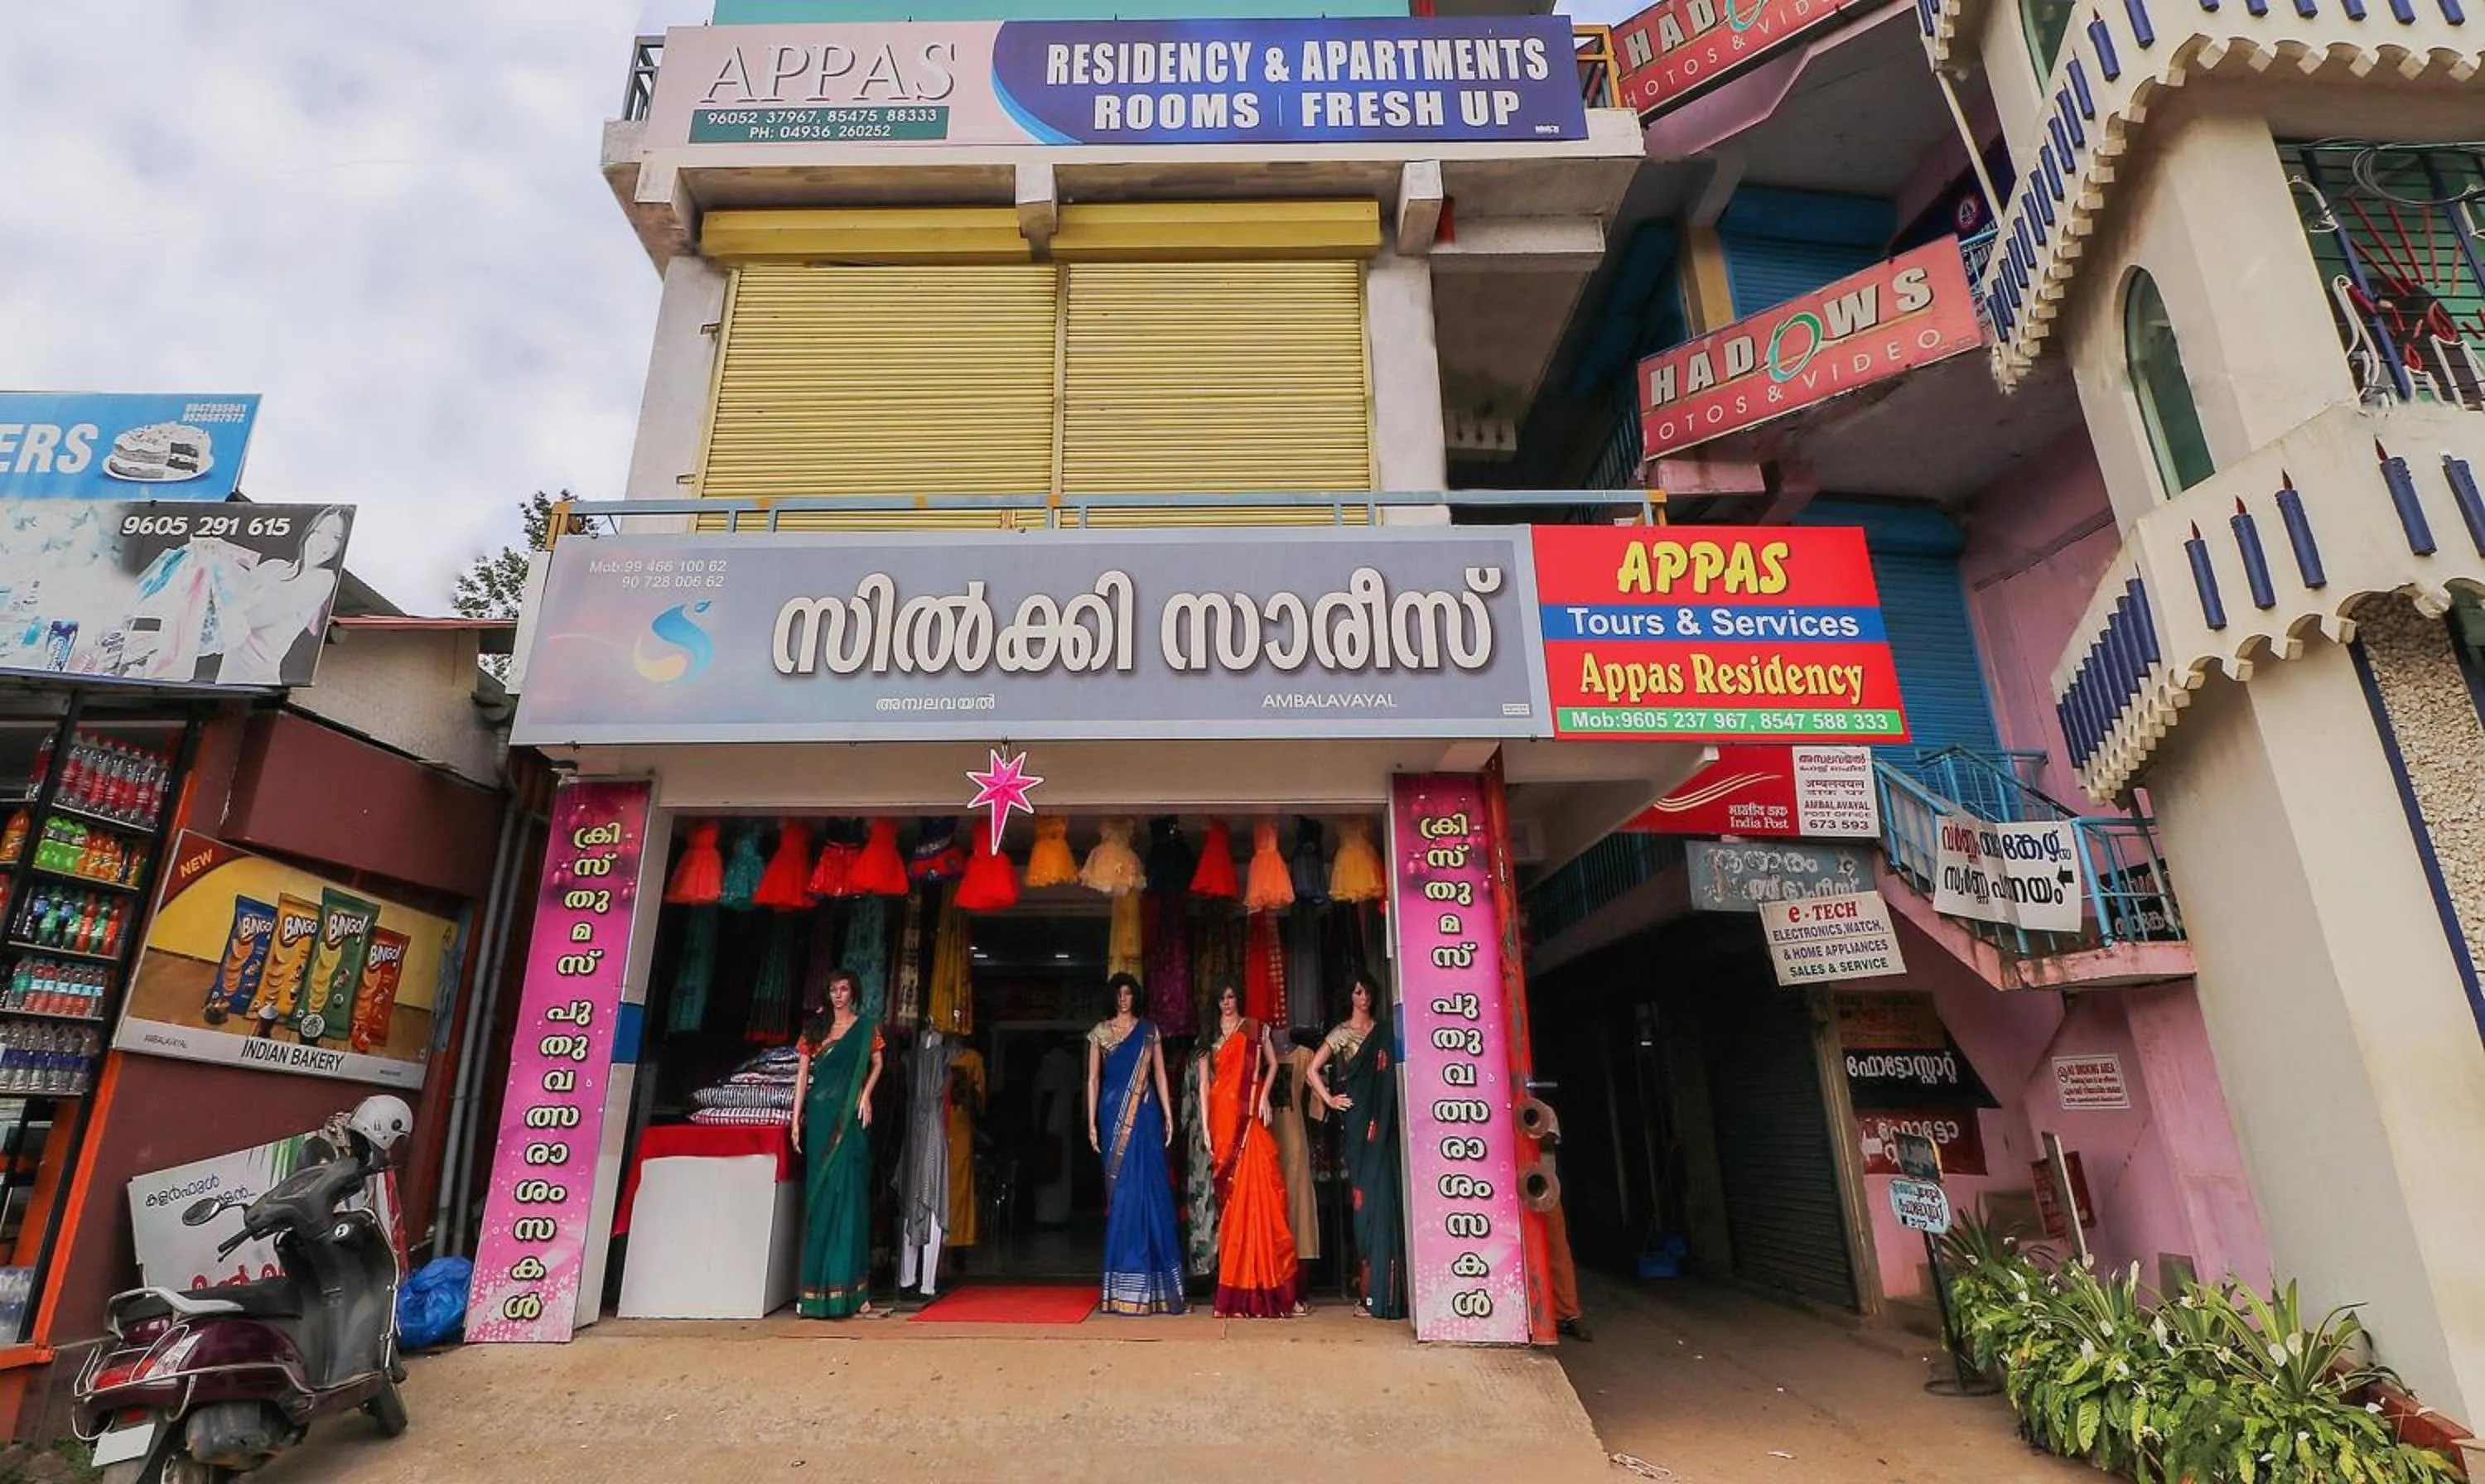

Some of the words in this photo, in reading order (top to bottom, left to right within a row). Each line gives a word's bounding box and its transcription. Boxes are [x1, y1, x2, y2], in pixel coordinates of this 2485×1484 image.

[1732, 34, 1745, 51] &
[700, 43, 956, 104] APPAS
[1045, 41, 1252, 85] RESIDENCY
[1264, 47, 1290, 83] &
[1300, 37, 1549, 81] APARTMENTS
[707, 112, 758, 125] 96052
[765, 110, 821, 125] 37967,
[828, 110, 878, 123] 85475
[886, 109, 937, 123] 88333
[1093, 92, 1260, 131] ROOMS
[1300, 90, 1444, 128] FRESH
[1460, 89, 1521, 126] UP
[749, 128, 775, 139] PH:
[779, 126, 831, 138] 04936
[838, 125, 891, 137] 260252
[1768, 385, 1783, 404] &
[1802, 328, 1942, 389] VIDEO
[122, 516, 188, 537] 9605
[194, 517, 240, 537] 291
[248, 518, 292, 537] 615
[680, 560, 704, 573] 100
[708, 560, 728, 573] 62
[1617, 541, 1789, 595] APPAS
[622, 576, 640, 589] 90
[644, 576, 671, 589] 728
[706, 576, 726, 588] 62
[772, 570, 1135, 673] സിൽക്കി
[1160, 566, 1502, 670] സാരീസ്
[1567, 607, 1666, 636] Tours
[1676, 609, 1702, 636] &
[1712, 610, 1860, 638] Services
[1580, 651, 1685, 703] Appas
[1690, 652, 1865, 706] Residency
[1262, 694, 1397, 708] AMBALAVAYAL
[1571, 711, 1668, 730] Mob:9605
[1674, 711, 1707, 730] 237
[1713, 712, 1756, 733] 967,
[1760, 713, 1806, 730] 8547
[1812, 713, 1848, 730] 588
[1854, 713, 1888, 730] 333
[1730, 816, 1762, 829] India
[1764, 817, 1789, 829] Post
[1809, 819, 1837, 829] 673
[1841, 820, 1870, 830] 593
[180, 848, 213, 878] NEW
[1784, 948, 1792, 961] &
[1793, 946, 1822, 960] HOME
[1826, 938, 1889, 956] APPLIANCES
[1789, 962, 1825, 977] SALES
[1829, 962, 1837, 973] &
[1840, 956, 1889, 972] SERVICE
[241, 1038, 288, 1065] INDIAN
[290, 1045, 345, 1072] BAKERY
